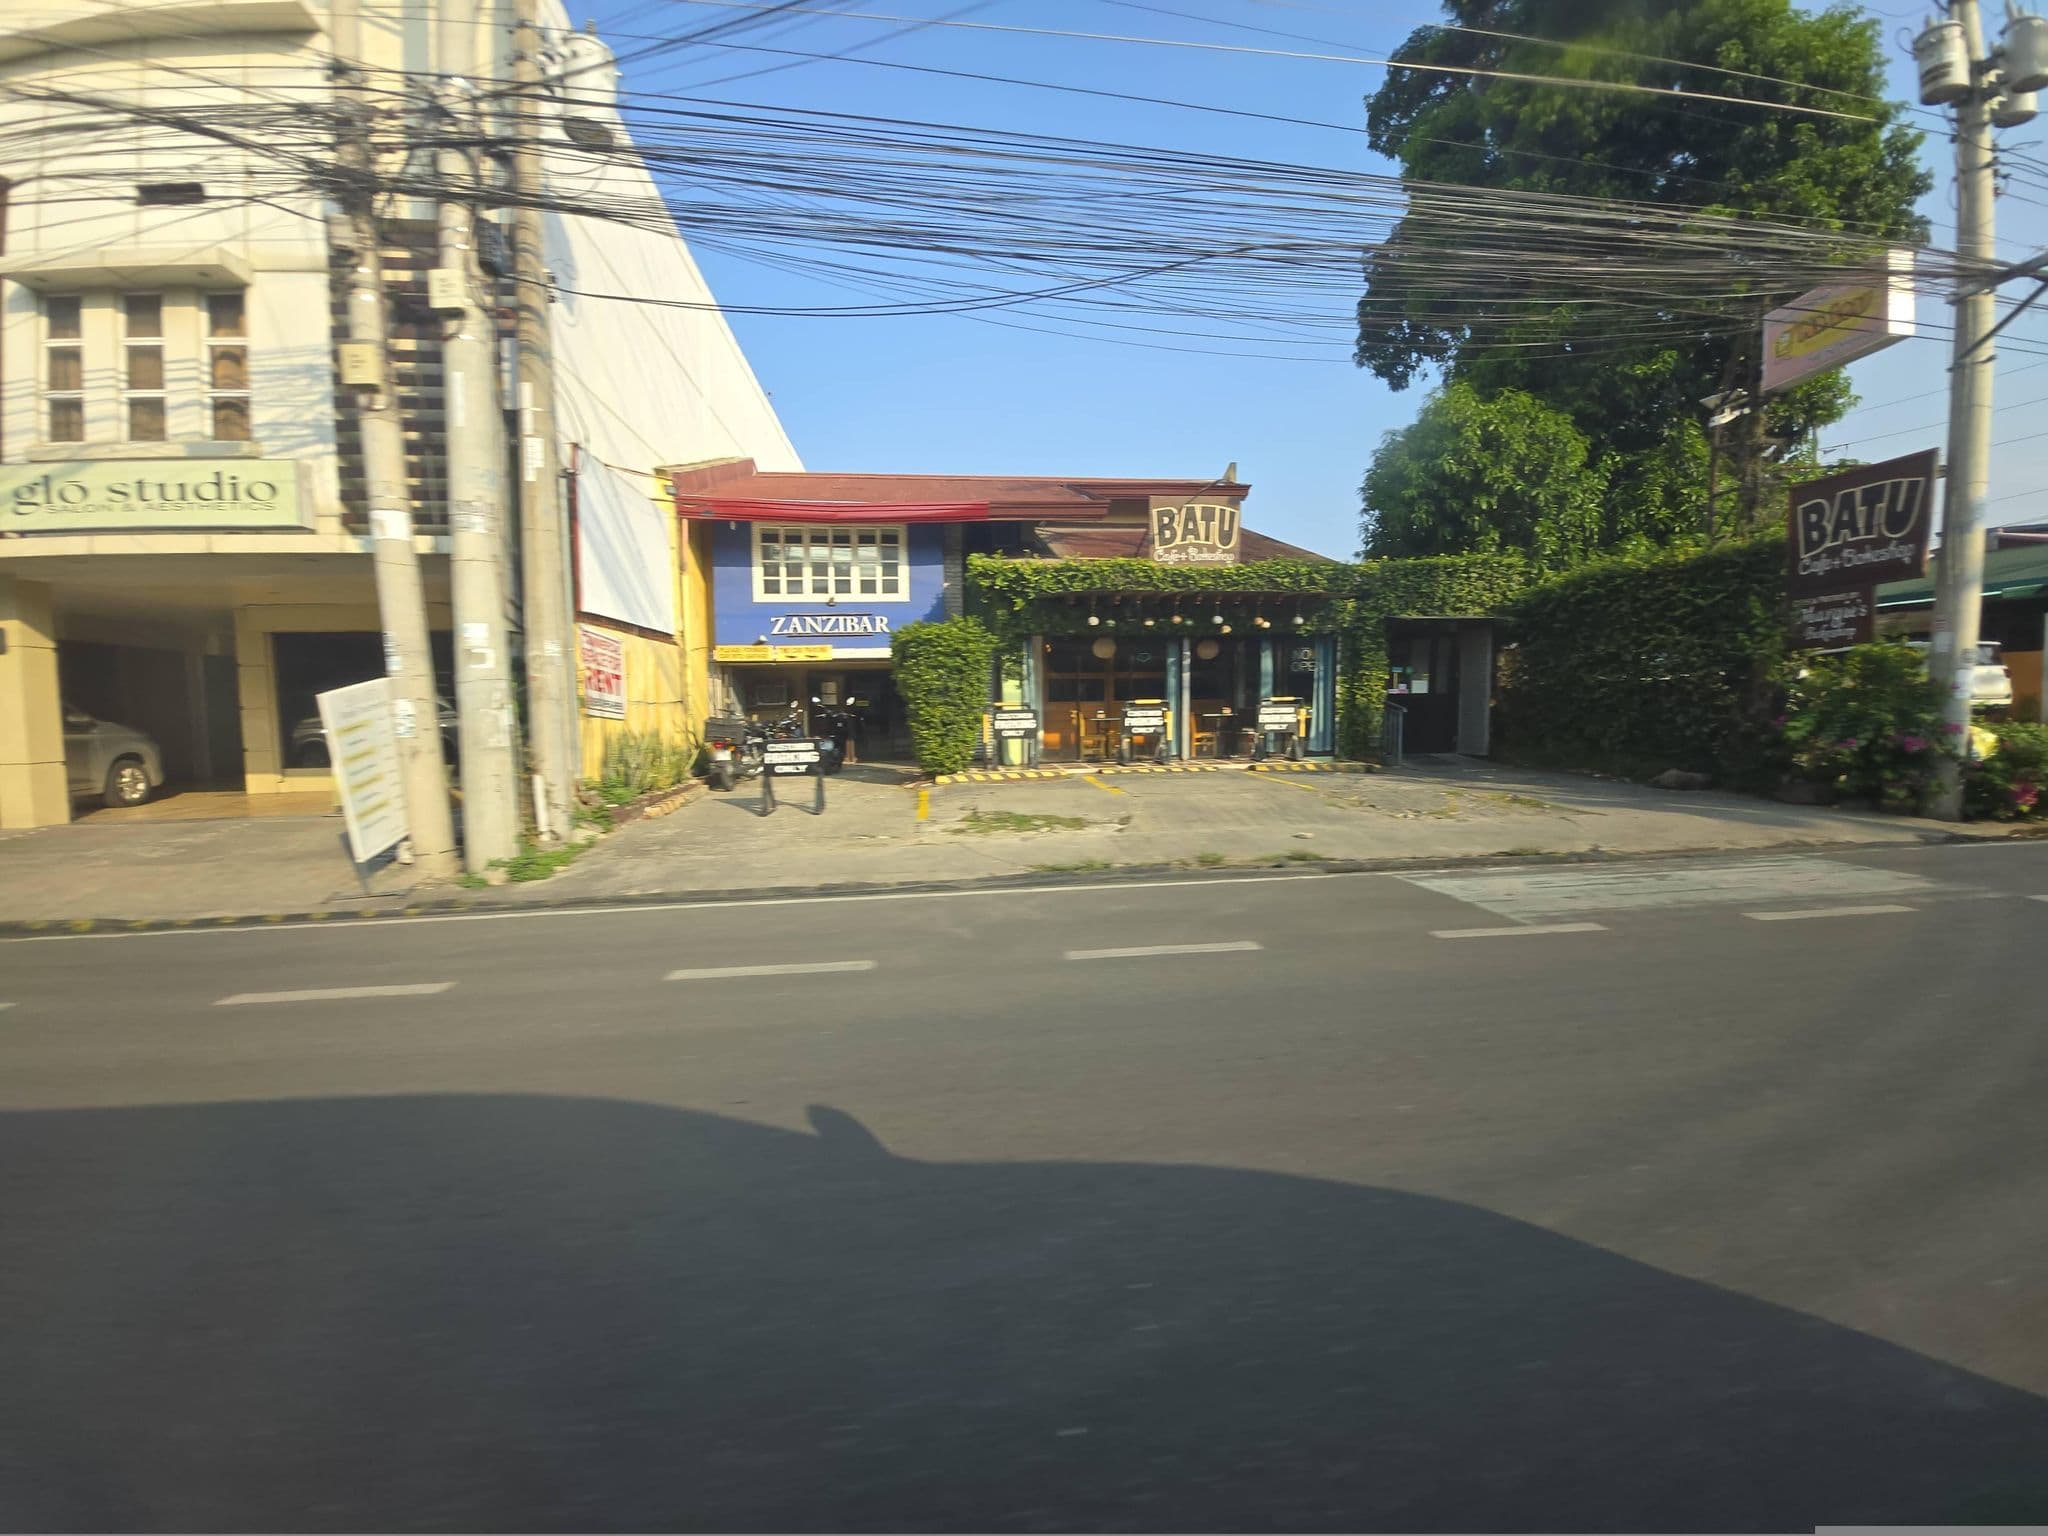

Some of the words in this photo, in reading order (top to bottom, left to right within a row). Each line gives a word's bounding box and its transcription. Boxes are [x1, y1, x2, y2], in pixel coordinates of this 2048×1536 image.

[106, 471, 277, 502] studio
[46, 503, 112, 514] SALON
[121, 503, 136, 513] &
[145, 502, 275, 512] AESTHETICS
[1798, 477, 1926, 559] BATU
[1152, 504, 1240, 549] BATU
[771, 615, 890, 635] ZANZIBAR
